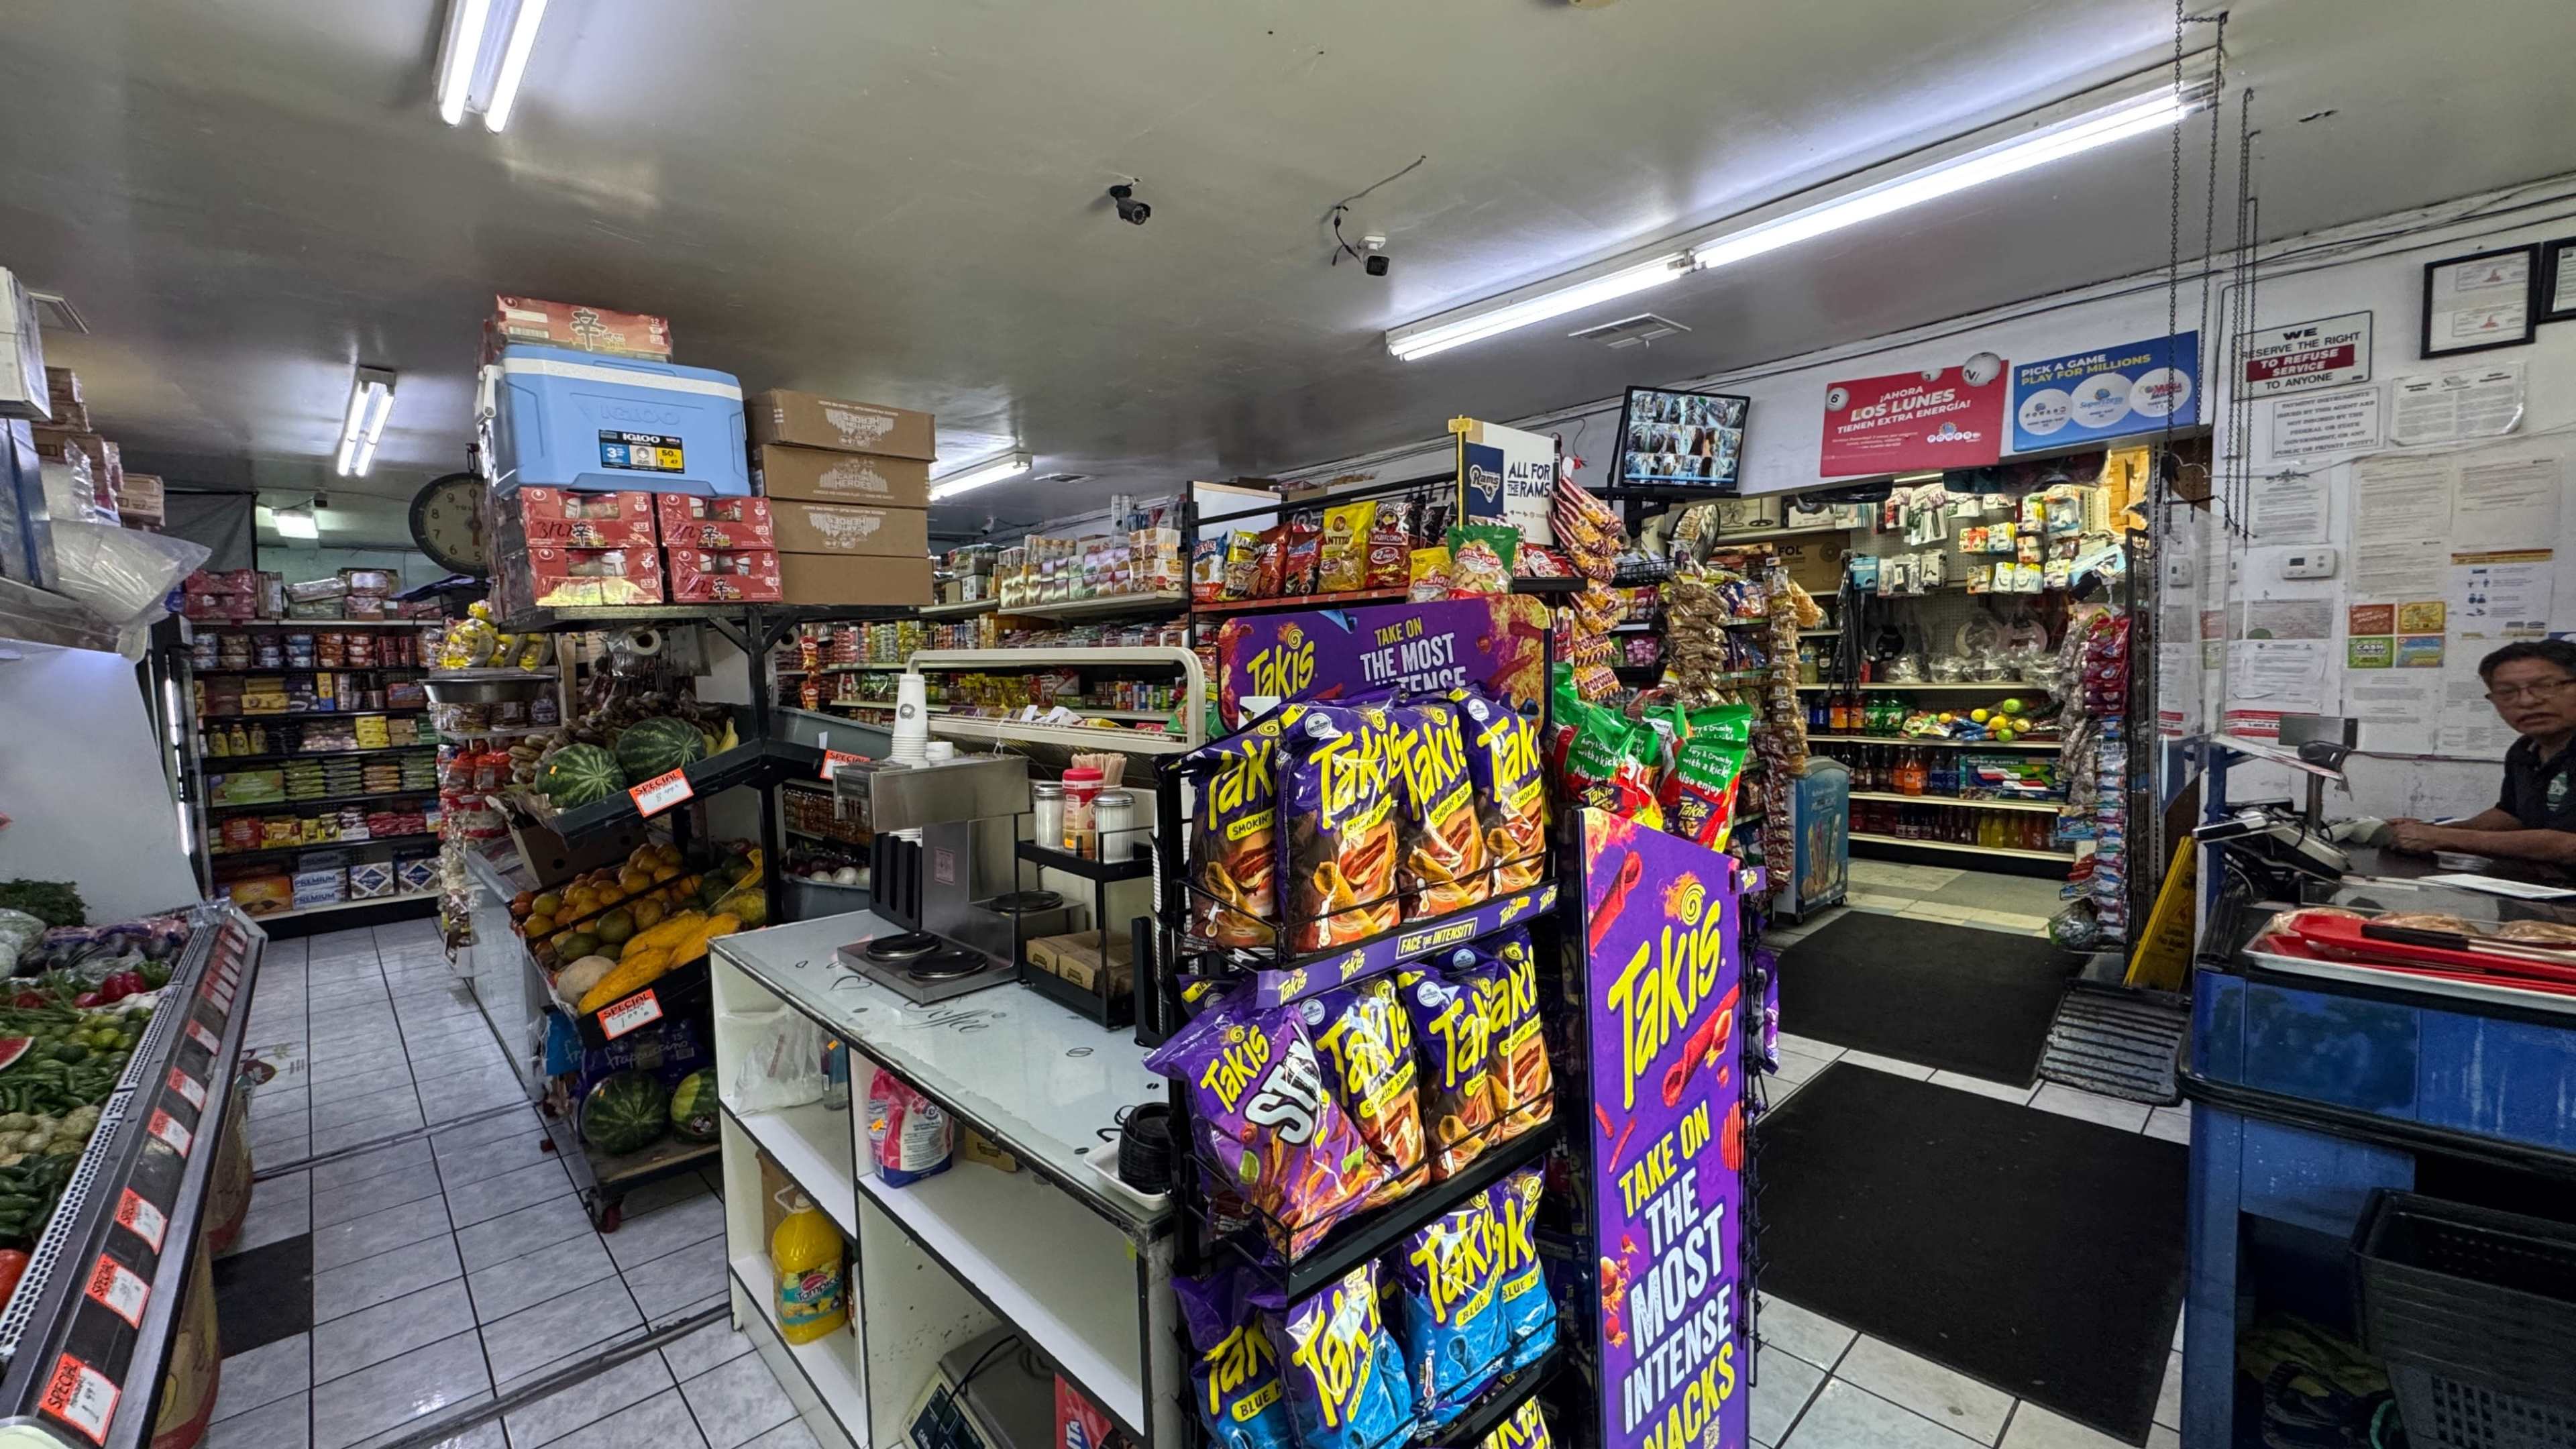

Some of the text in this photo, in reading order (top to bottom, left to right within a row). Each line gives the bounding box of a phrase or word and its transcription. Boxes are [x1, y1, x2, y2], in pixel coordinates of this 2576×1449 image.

[2241, 331, 2361, 359] RESERVE THE RIGHT
[2283, 327, 2318, 340] WE
[2021, 354, 2107, 377] PICK A GAME
[2021, 354, 2151, 386] PLAY FOR MILLIONS
[2260, 348, 2340, 369] TO REFUSE
[2272, 361, 2326, 377] SERVICE
[2265, 372, 2333, 390] TO ANYONE
[1851, 388, 1956, 422] LOS LUNES
[1880, 386, 1924, 402] ¡AHORA
[2282, 391, 2370, 409] PAYMENT INSTRUMENTS
[1837, 400, 1972, 434] TIENEN EXTRA ENERGÍA!
[2277, 410, 2302, 419] ISSUED
[2333, 402, 2357, 411] AGENT
[2303, 415, 2334, 424] INSURED
[623, 433, 660, 443] IGLOO
[2284, 434, 2337, 445] GOVERNMENT,
[2290, 427, 2322, 435] FEDERAL
[606, 447, 616, 458] 3
[2275, 447, 2301, 455] PUBLIC
[2315, 443, 2344, 451] PRIVATE
[2347, 439, 2375, 447] ENTITY
[1472, 465, 1501, 488] Rams
[1507, 462, 1550, 480] ALL FOR
[1507, 480, 1550, 499] THE RAMS
[449, 544, 458, 555] 6
[474, 551, 482, 561] 5
[1778, 545, 1803, 555] FOL
[1375, 617, 1424, 647] TAKE ON
[1246, 634, 1316, 696] Takis
[1360, 633, 1455, 682] THE MOST
[1584, 672, 1617, 694] POPCORN
[1709, 724, 1733, 734] Crunchy
[1401, 714, 1467, 821] Takis
[1682, 757, 1701, 769] with
[1708, 753, 1733, 766] Crunchy
[635, 773, 679, 796] SPECIAL
[1309, 722, 1403, 830] Takis
[1697, 780, 1723, 798] enjoy
[1435, 796, 1456, 823] SMOKIN'
[1678, 802, 1709, 818] Takis
[294, 874, 336, 888] PREMIUM
[293, 892, 335, 905] PREMIUM
[1499, 887, 1558, 927] Takis Takis
[1401, 934, 1422, 954] FACE
[1433, 922, 1475, 945] INTENSITY
[1277, 953, 1366, 1005] Takis Takis
[604, 992, 651, 1018] SPECIAL
[1608, 900, 1723, 1110] Takis
[606, 1040, 688, 1070] frappuccino
[1316, 1000, 1410, 1106] Takis
[1200, 1025, 1269, 1114] Takis
[1395, 1070, 1409, 1087] BBQ
[1618, 1099, 1710, 1218] TAKE ON
[1645, 1167, 1700, 1257] THE
[92, 1262, 114, 1297] SPECIAL
[1629, 1203, 1724, 1360] MOST
[1462, 1294, 1485, 1321] BLUE
[1623, 1283, 1731, 1435] INTENSE
[48, 1363, 78, 1409] SPECIAL
[1240, 1390, 1271, 1417] BLUE
